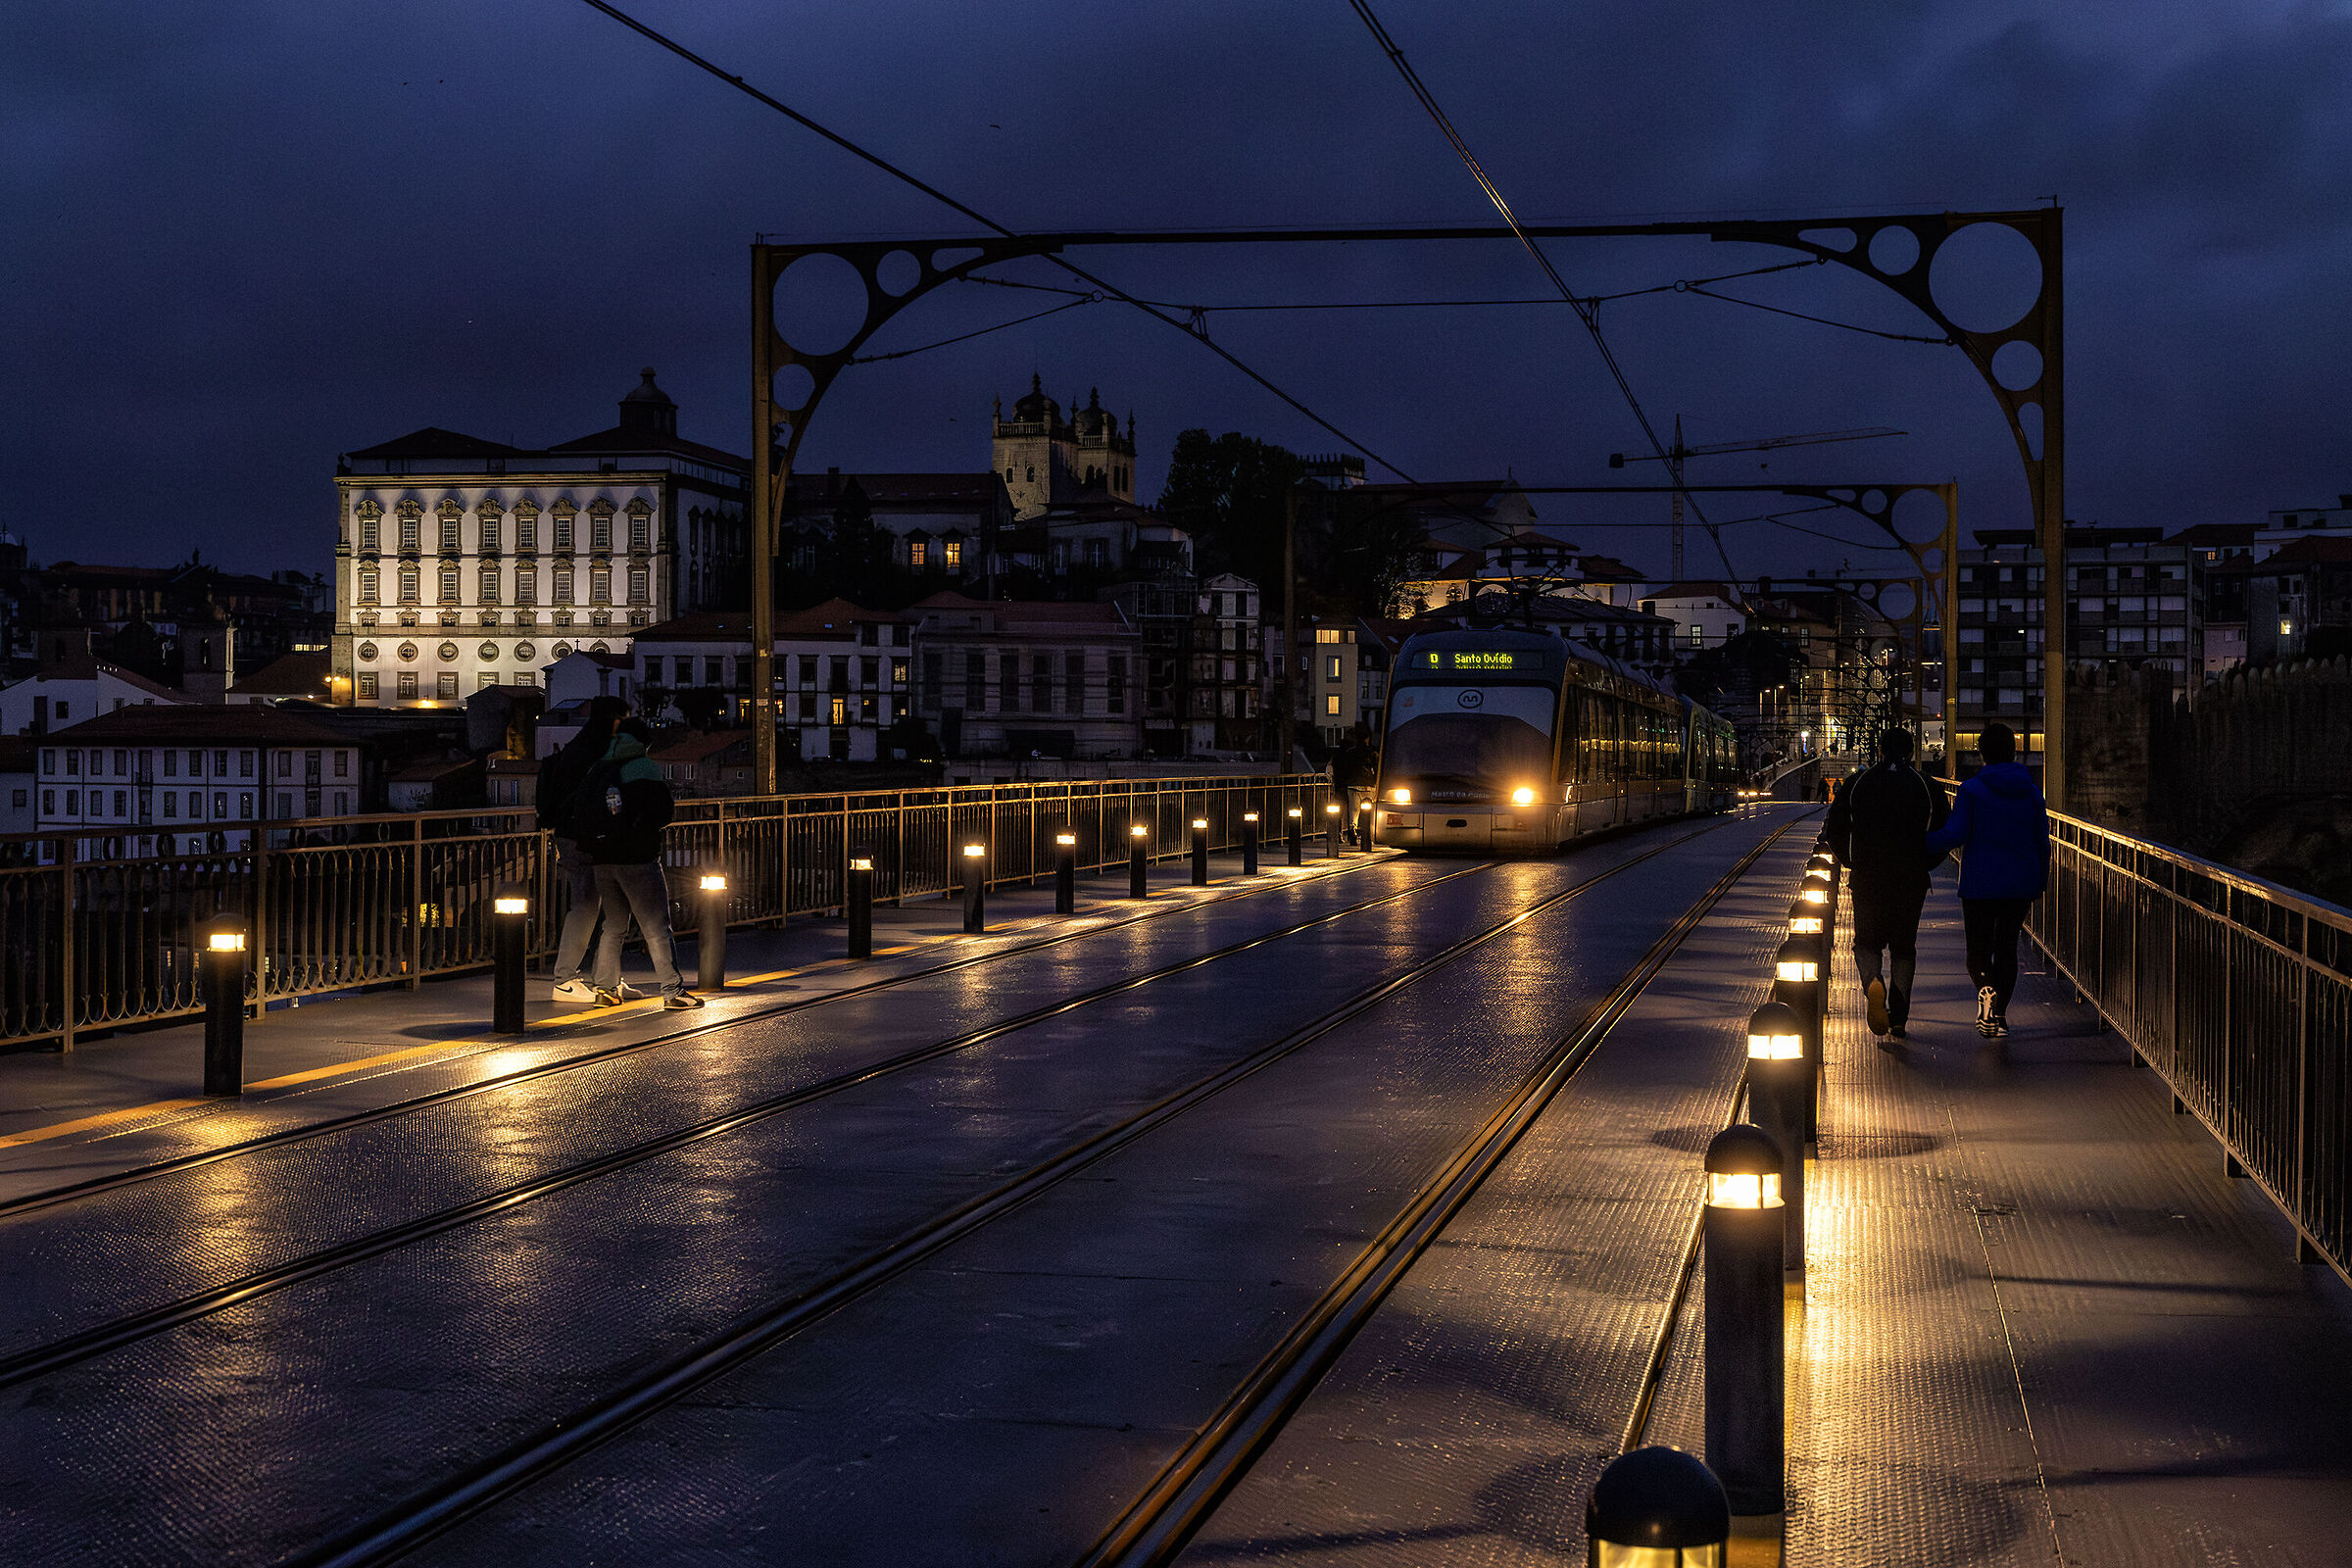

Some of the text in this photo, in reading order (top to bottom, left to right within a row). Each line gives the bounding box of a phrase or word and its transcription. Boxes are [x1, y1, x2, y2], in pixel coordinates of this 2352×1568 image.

[1430, 653, 1513, 663] D Santo Ovídio
